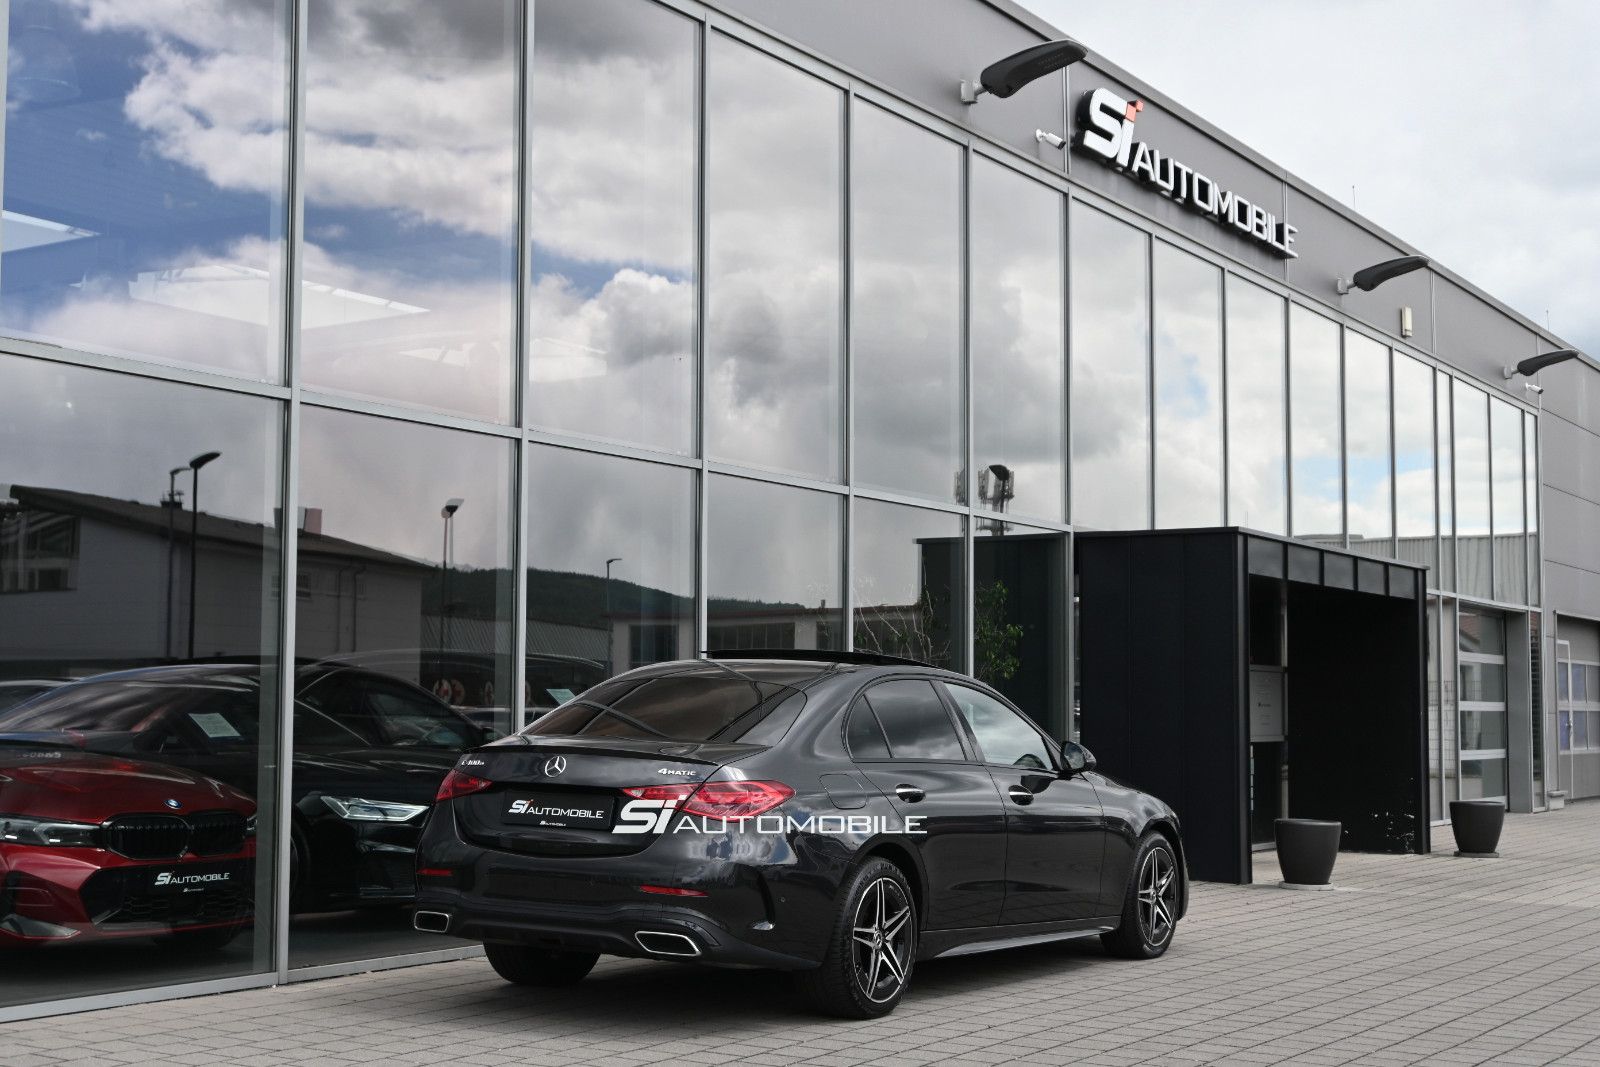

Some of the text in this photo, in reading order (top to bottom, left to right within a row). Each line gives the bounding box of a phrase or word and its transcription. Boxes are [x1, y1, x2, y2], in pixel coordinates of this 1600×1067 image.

[1131, 141, 1298, 259] AUTOMOBILE
[657, 767, 697, 776] 4MATIC
[526, 806, 605, 819] AUTOMOBILE
[170, 872, 230, 885] AUTOMOBILE
